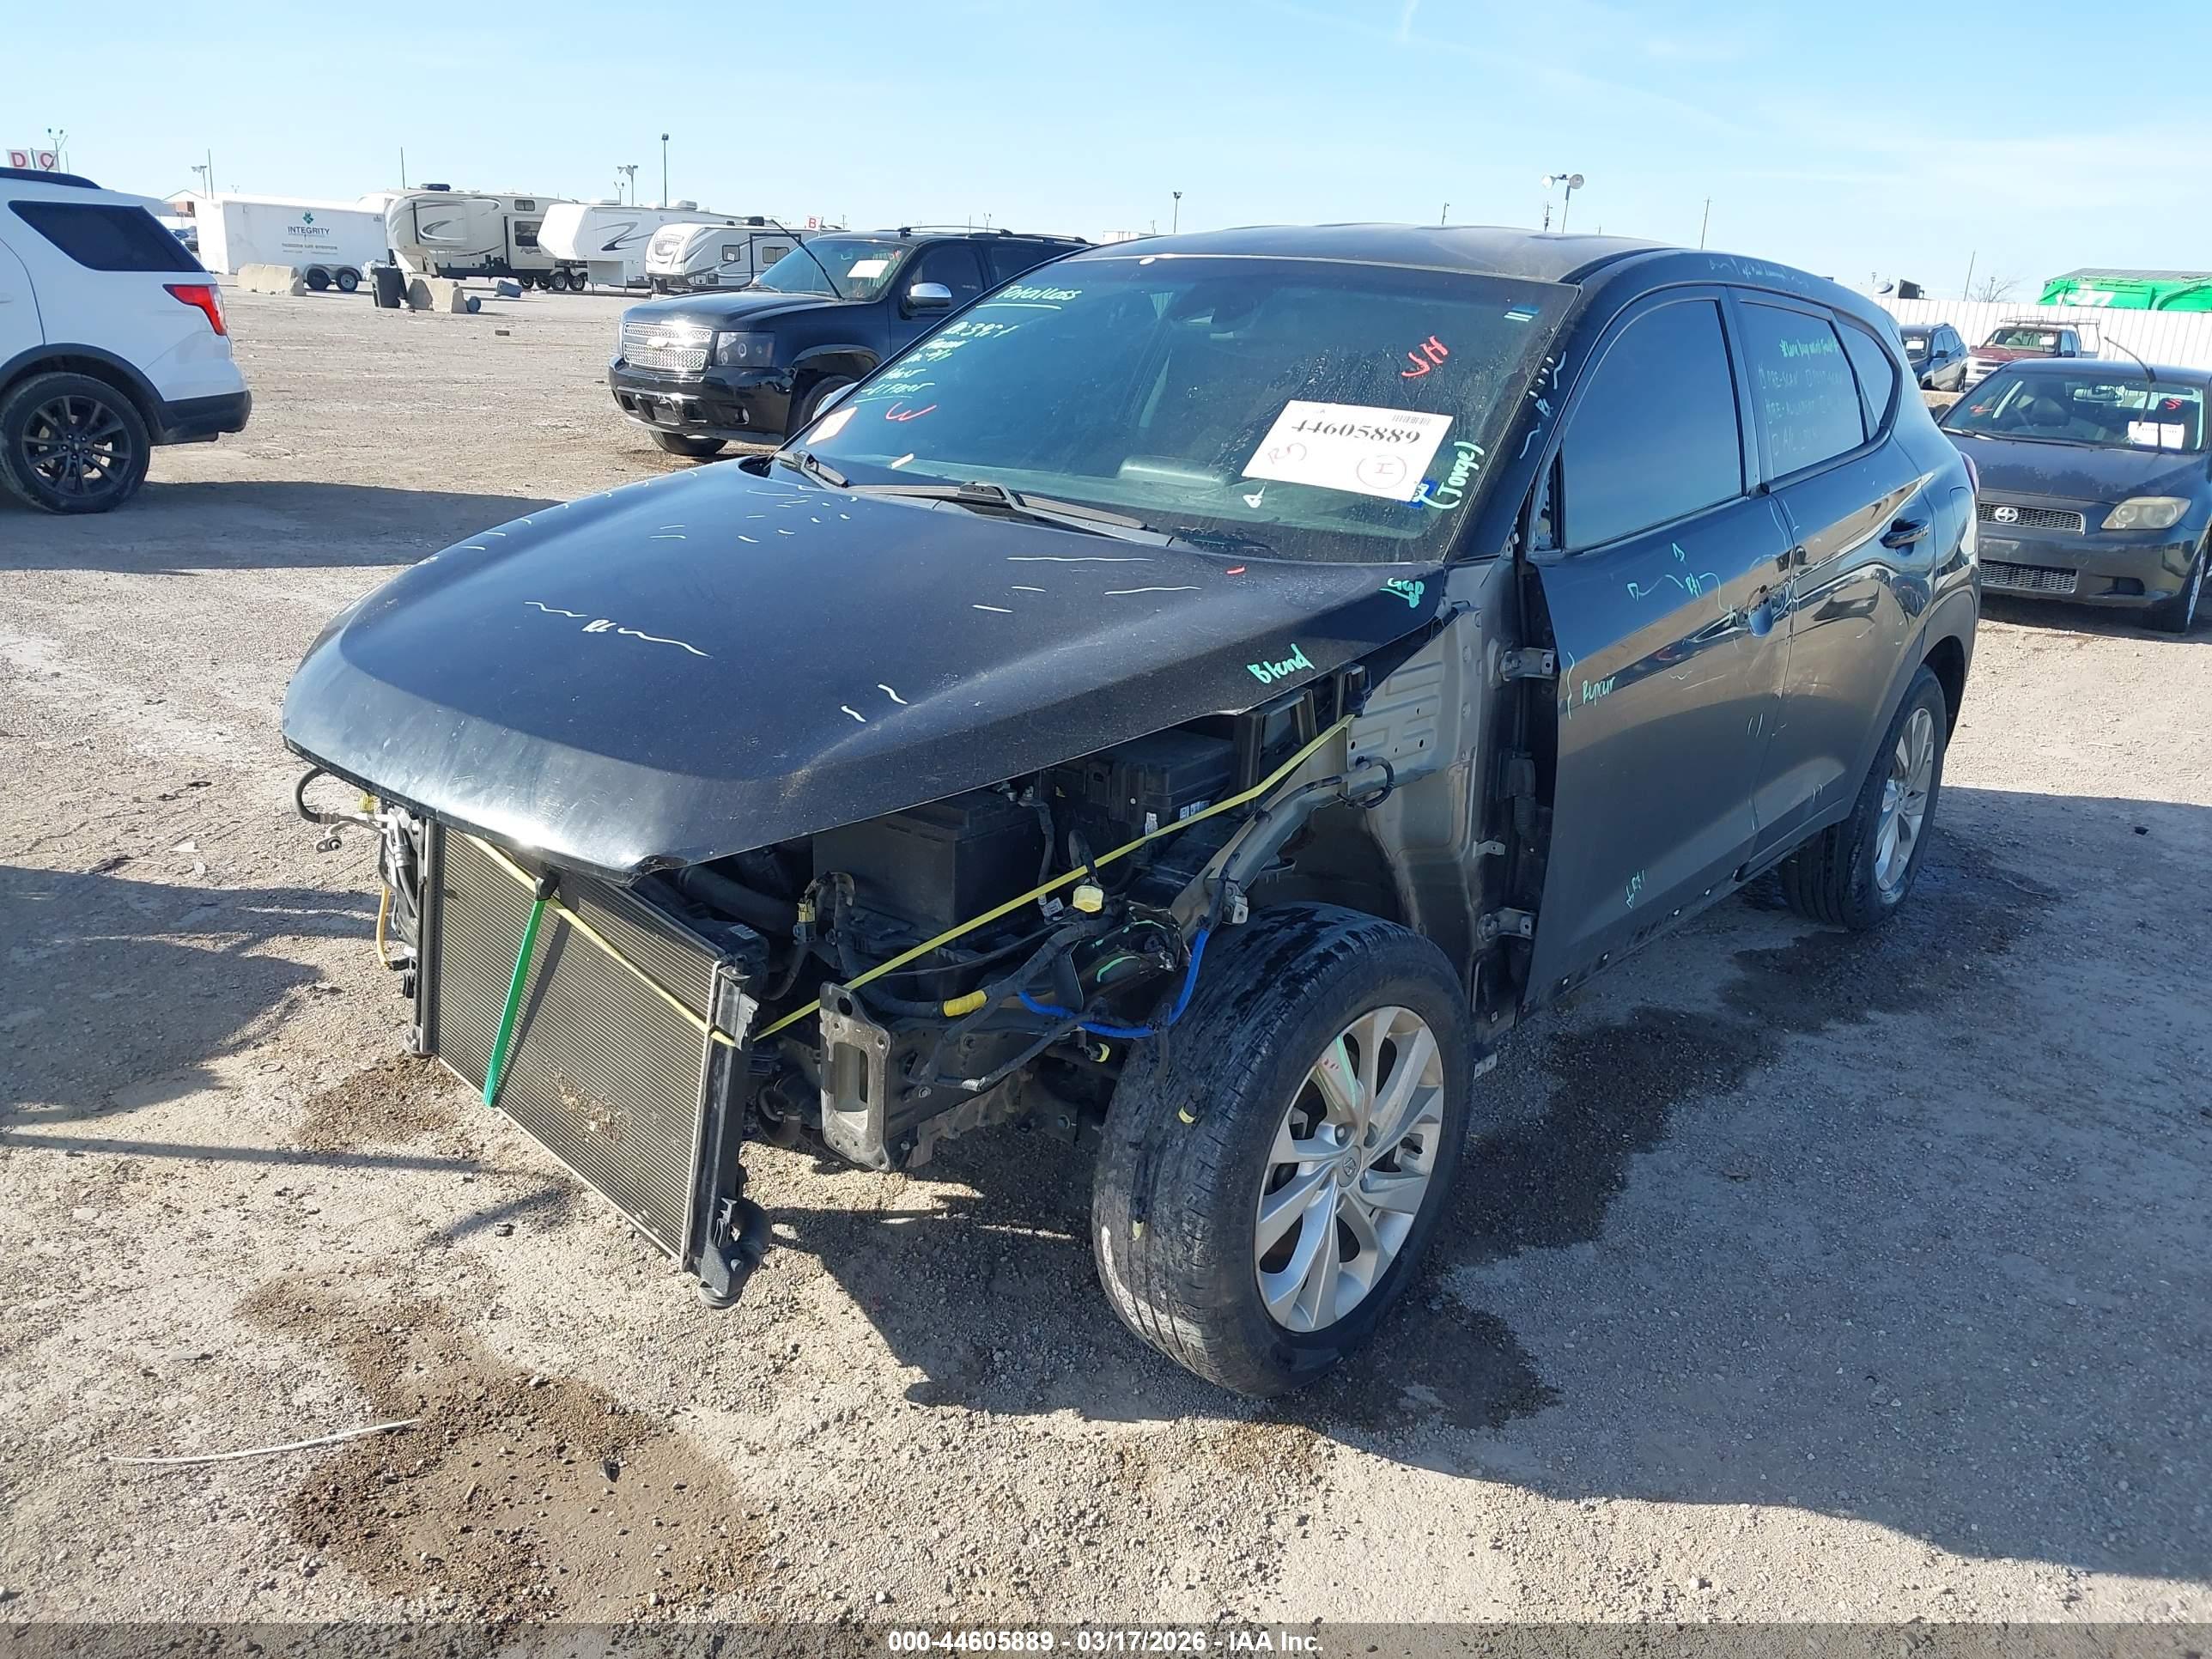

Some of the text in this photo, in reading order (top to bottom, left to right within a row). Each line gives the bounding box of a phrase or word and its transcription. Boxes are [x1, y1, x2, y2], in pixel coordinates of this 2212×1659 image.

[10, 151, 27, 167] D
[808, 218, 817, 228] B
[288, 226, 331, 234] INTEGRITY
[1291, 419, 1421, 445] 44605889
